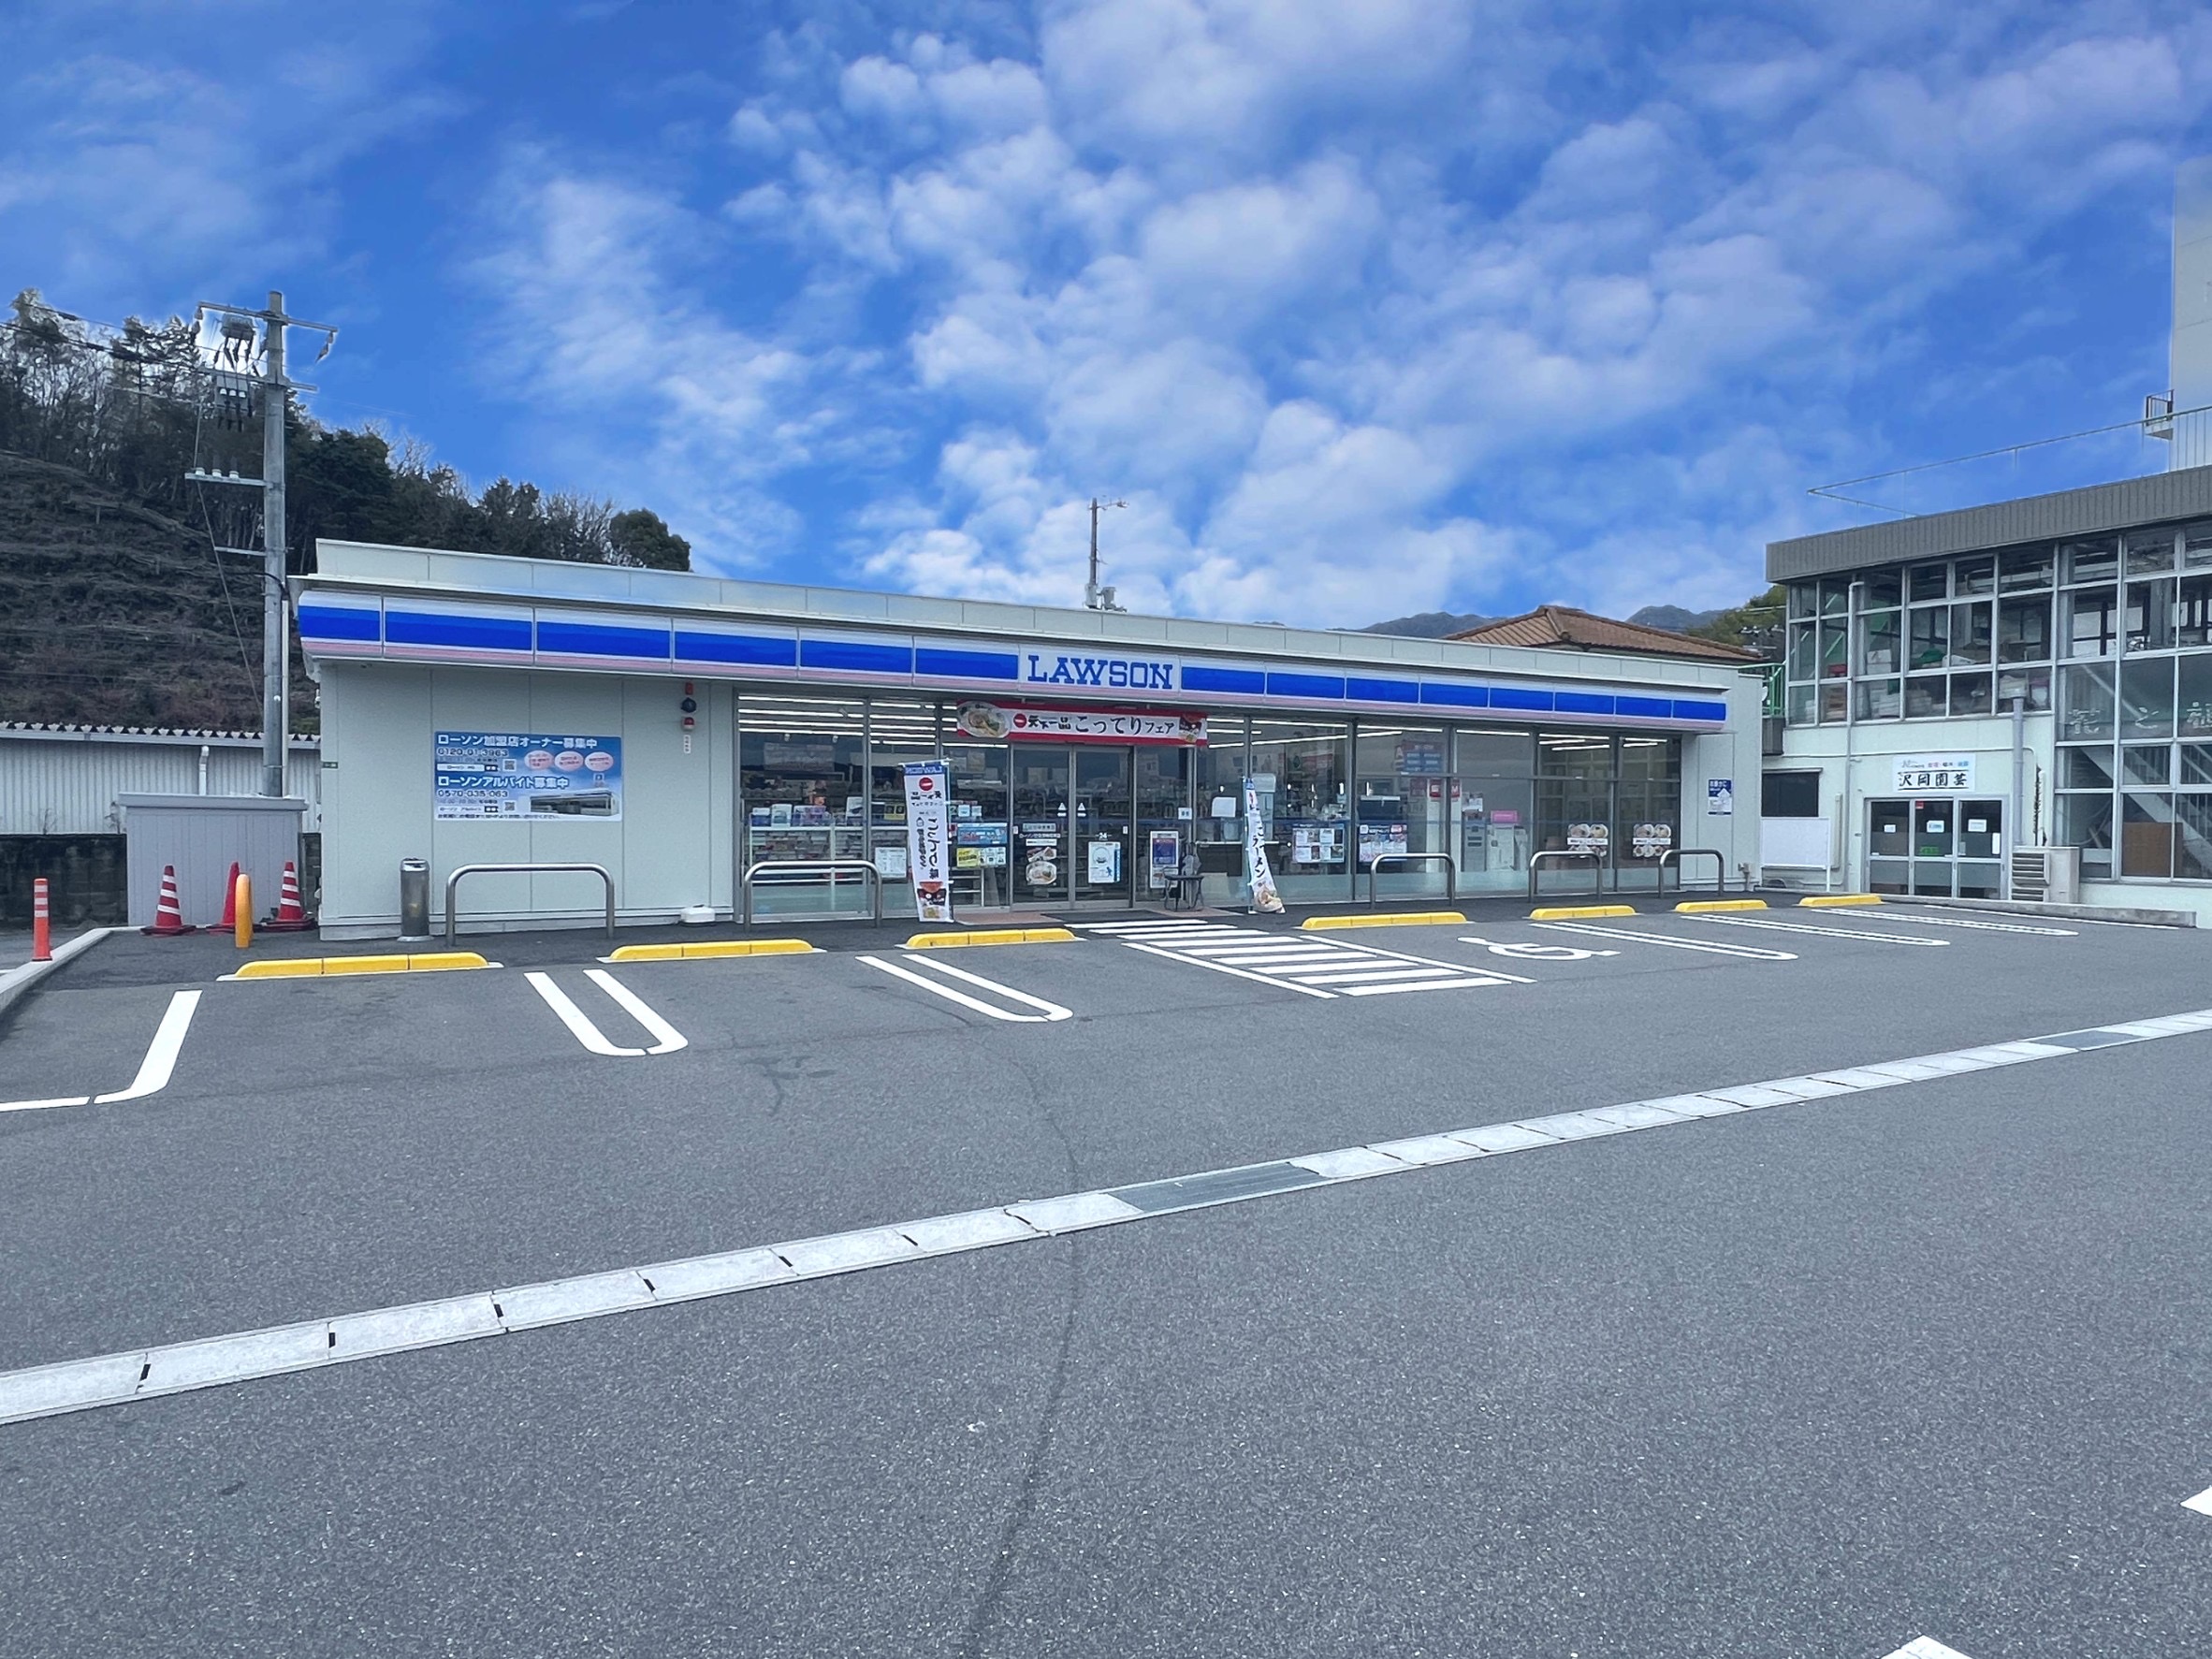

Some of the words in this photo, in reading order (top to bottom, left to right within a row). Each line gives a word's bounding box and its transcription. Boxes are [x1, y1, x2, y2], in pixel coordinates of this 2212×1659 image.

[1027, 655, 1172, 690] LAWSON
[438, 735, 597, 749] ローソン加盟店オーナー募集中
[438, 776, 569, 789] ローソンアルバイト募集中
